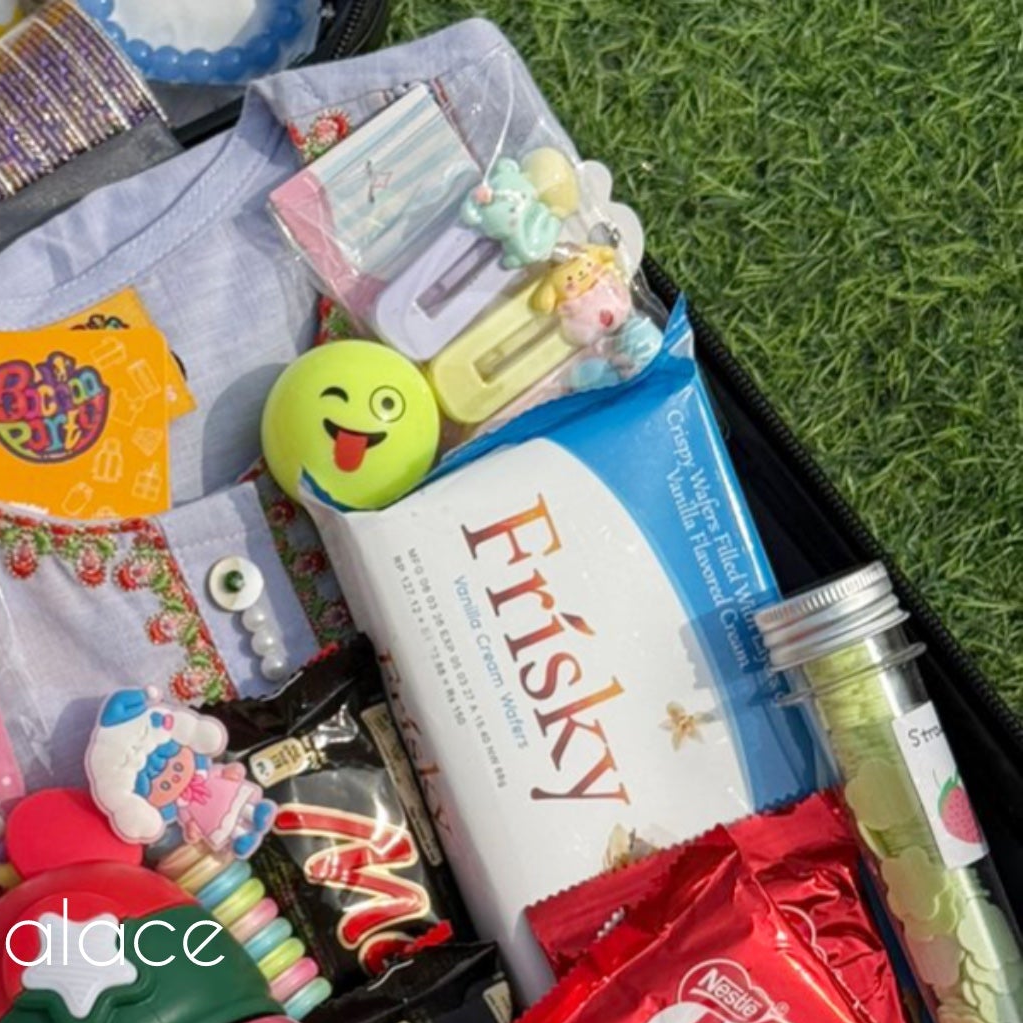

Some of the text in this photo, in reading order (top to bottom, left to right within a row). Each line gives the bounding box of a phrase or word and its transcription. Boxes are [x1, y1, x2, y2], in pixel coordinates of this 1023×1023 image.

[666, 409, 697, 471] Crispy
[689, 467, 721, 533] Wafers
[714, 531, 749, 584] Filled
[666, 466, 751, 668] Vanilla Flavored Cream
[454, 574, 529, 749] Vanilla Cream Wafers
